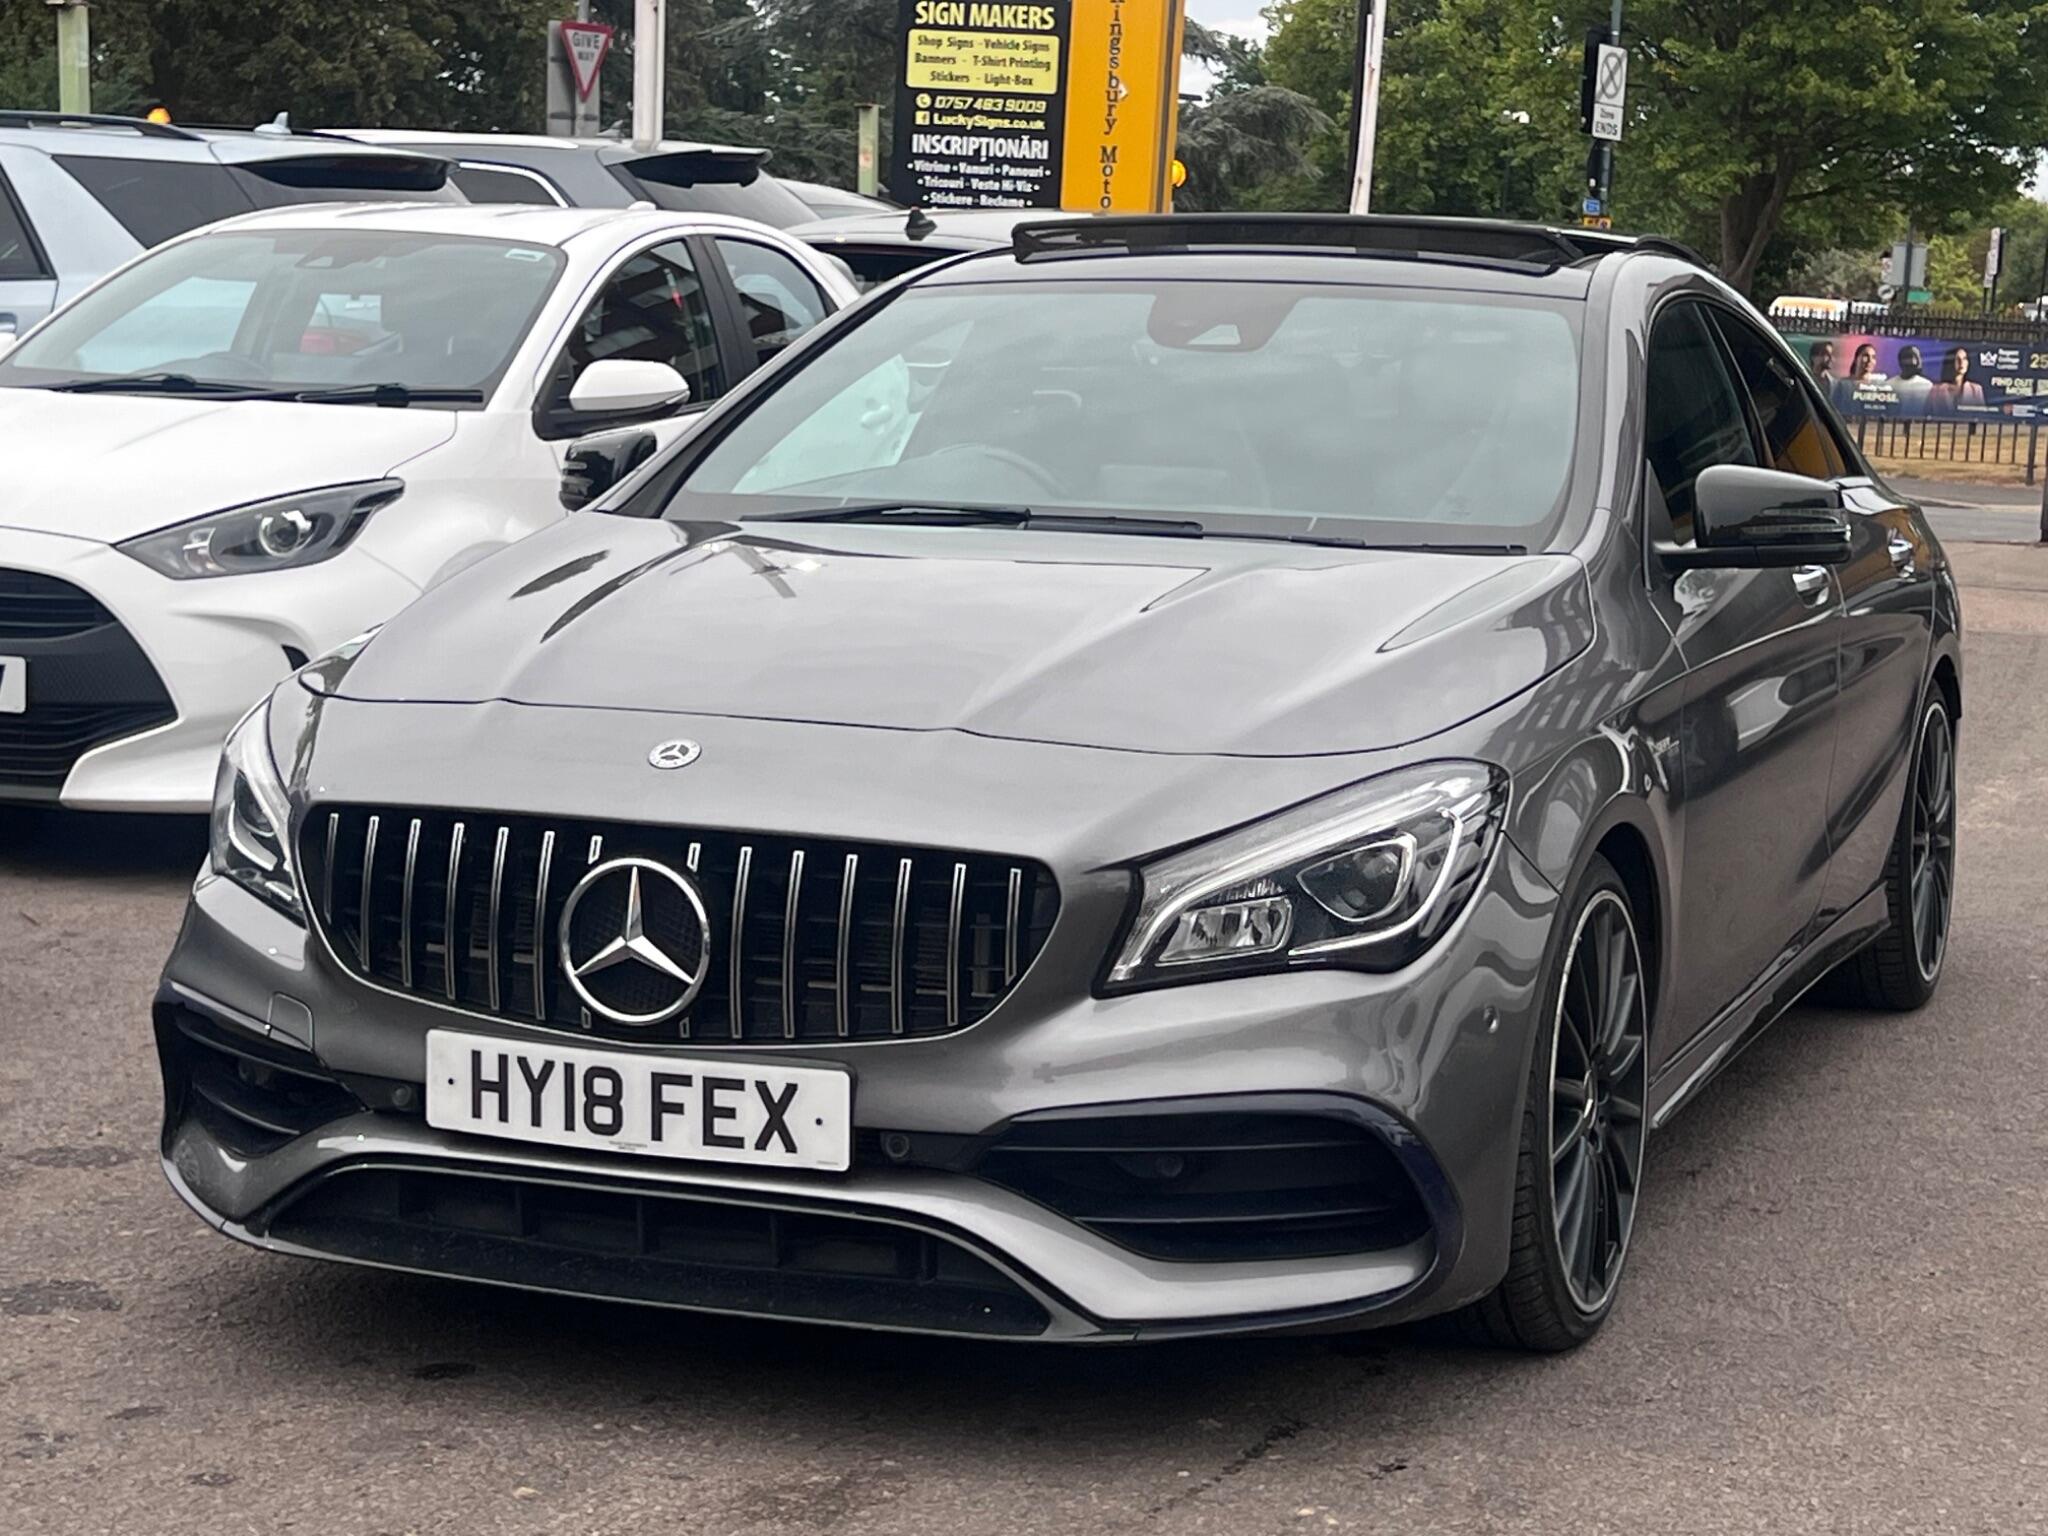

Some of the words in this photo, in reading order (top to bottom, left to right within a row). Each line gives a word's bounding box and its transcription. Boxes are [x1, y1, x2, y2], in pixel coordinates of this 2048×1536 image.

[915, 1, 965, 26] SIGN
[969, 3, 1056, 30] MAKERS
[573, 32, 600, 49] GIVE
[918, 35, 943, 48] Shop
[947, 36, 974, 50] Signs
[984, 38, 1020, 51] Vehicle
[1022, 40, 1050, 54] Signs
[915, 52, 957, 64] Banners
[973, 55, 1007, 67] T-Shirt
[1009, 57, 1052, 72] Printing
[1104, 0, 1126, 135] ingsbury
[930, 70, 970, 82] Stickers
[984, 73, 1034, 87] Light-Box
[934, 96, 974, 110] 0757
[933, 112, 1046, 130] LuckySigns.co.uk
[1595, 121, 1618, 136] ENDS
[914, 160, 951, 173] Vitrine
[959, 162, 995, 175] Vanuri
[1002, 164, 1044, 177] Panouri
[924, 176, 964, 189] Tricouri
[980, 194, 1025, 208] Reclame
[471, 1049, 623, 1137] HY18
[650, 1070, 798, 1154] FEX
